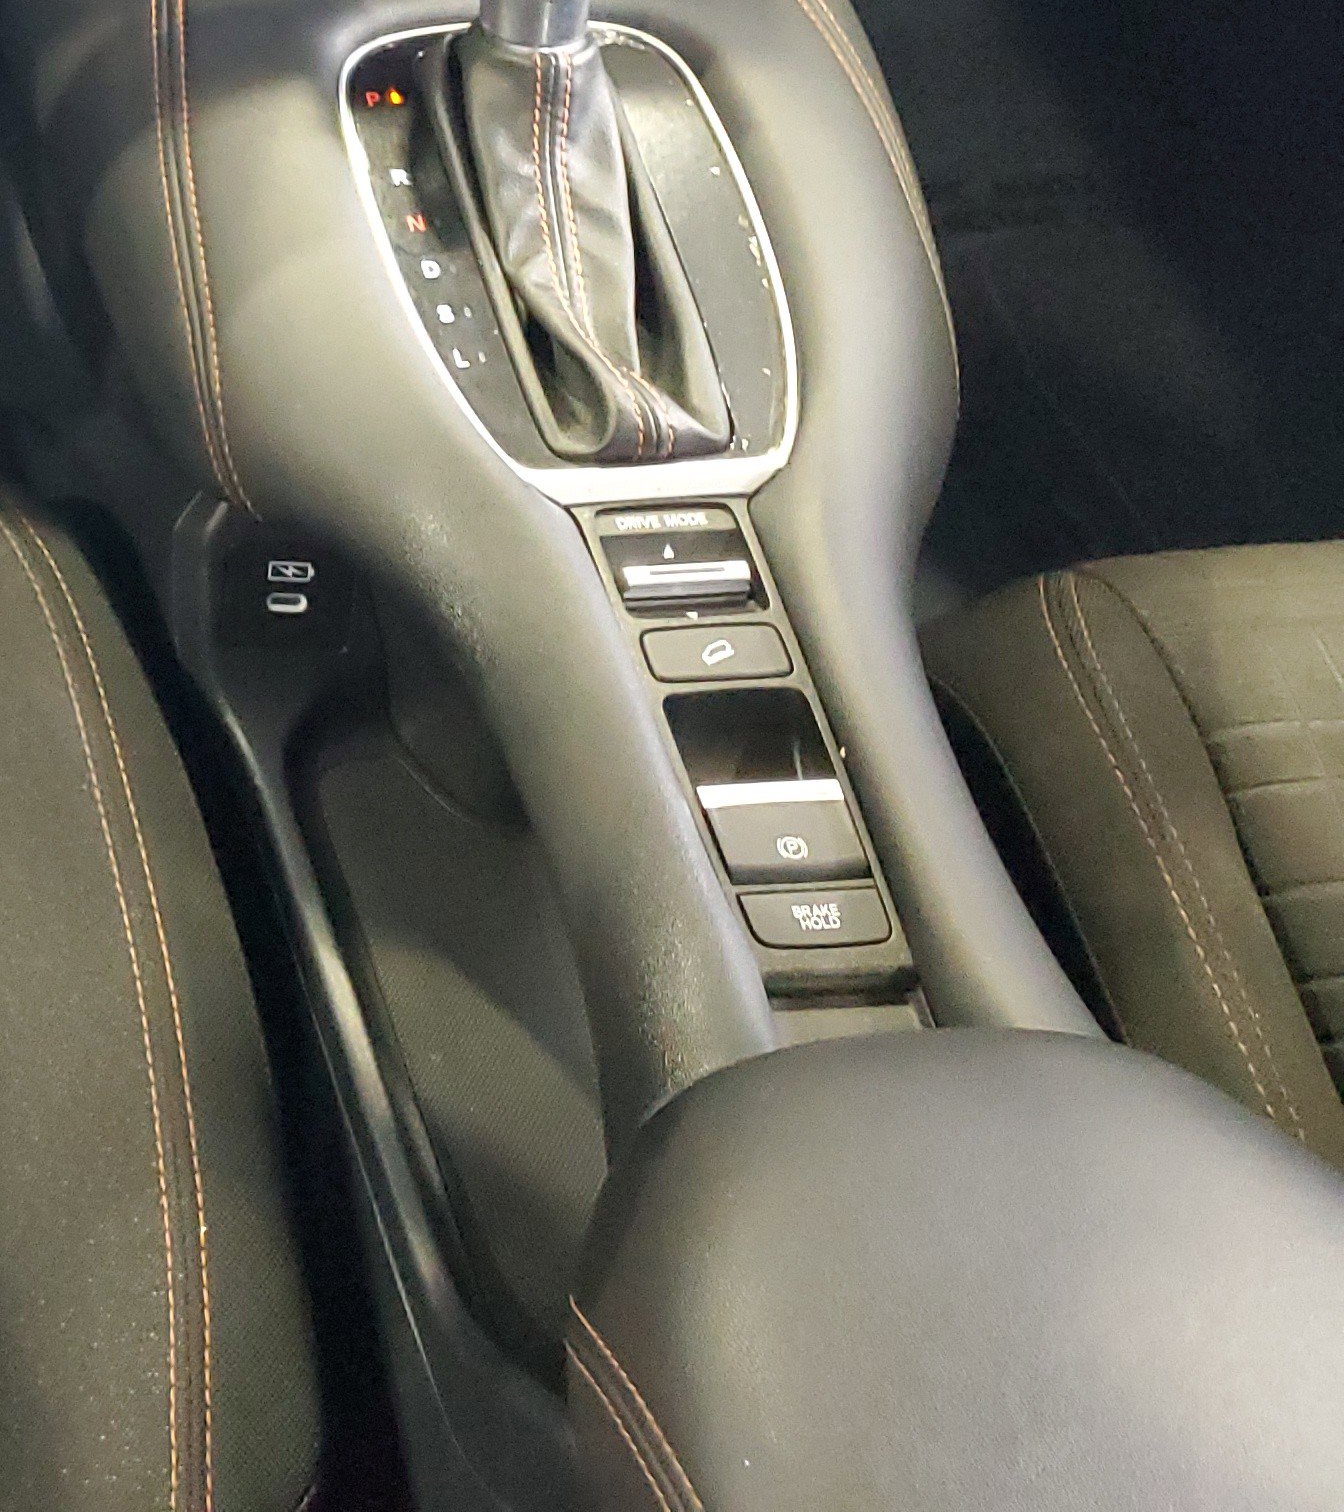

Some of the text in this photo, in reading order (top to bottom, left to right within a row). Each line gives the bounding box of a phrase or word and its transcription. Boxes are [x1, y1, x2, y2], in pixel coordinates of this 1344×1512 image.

[365, 91, 380, 107] P
[406, 214, 426, 232] N
[420, 259, 441, 279] D
[452, 348, 471, 368] L
[615, 512, 708, 531] DRIVE MODE
[791, 904, 841, 919] BRAKE
[800, 916, 841, 930] HOLD
